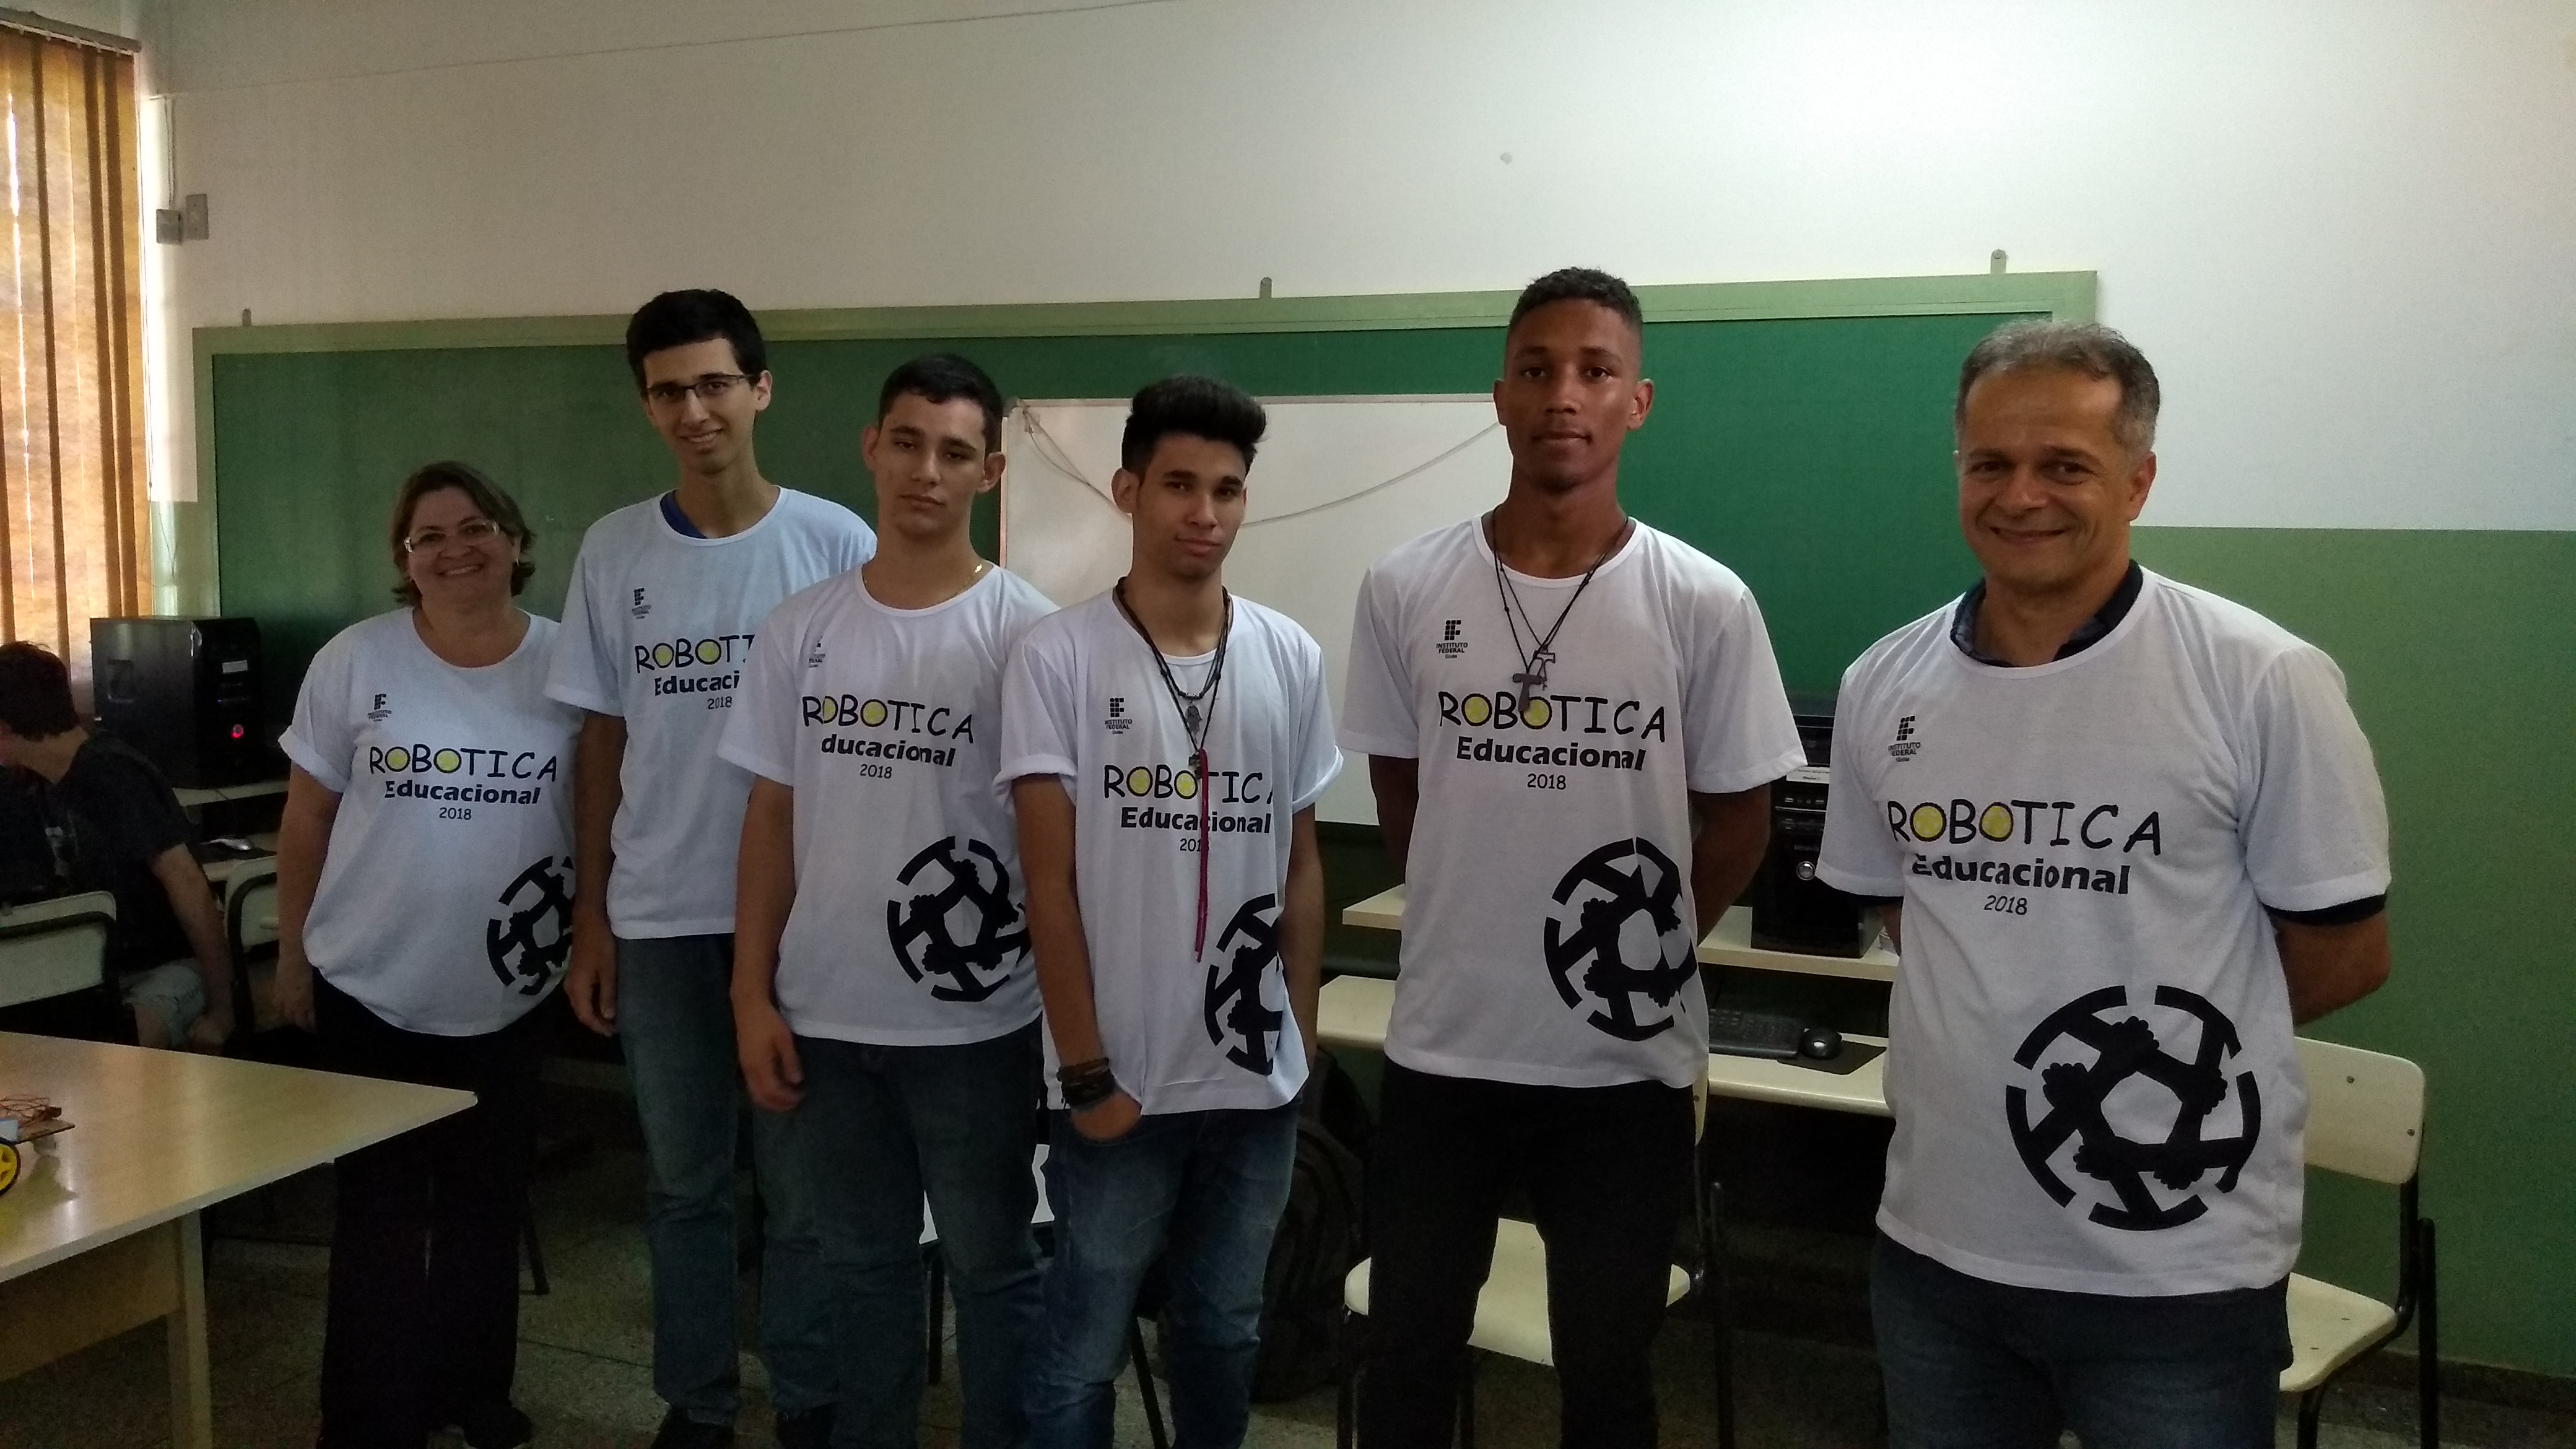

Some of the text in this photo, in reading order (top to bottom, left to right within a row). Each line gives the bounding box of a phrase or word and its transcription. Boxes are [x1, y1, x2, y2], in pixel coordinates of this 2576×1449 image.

[655, 670, 740, 696] Educaci
[707, 696, 733, 710] 2018
[802, 694, 974, 744] ROBOTICA
[1438, 690, 1666, 743] ROBOTICA
[370, 743, 557, 782] ROBOTICA
[1456, 736, 1647, 771] Educacional
[859, 764, 892, 779] 2018
[1103, 764, 1273, 804] ROBOIC
[1526, 773, 1567, 790] 2018
[384, 779, 541, 804] Educacional
[438, 807, 472, 820] 2018
[1887, 798, 2161, 856] ROBOTICA
[1180, 838, 1209, 852] 201
[1912, 853, 2131, 895] Educacional
[1983, 895, 2028, 915] 2018
